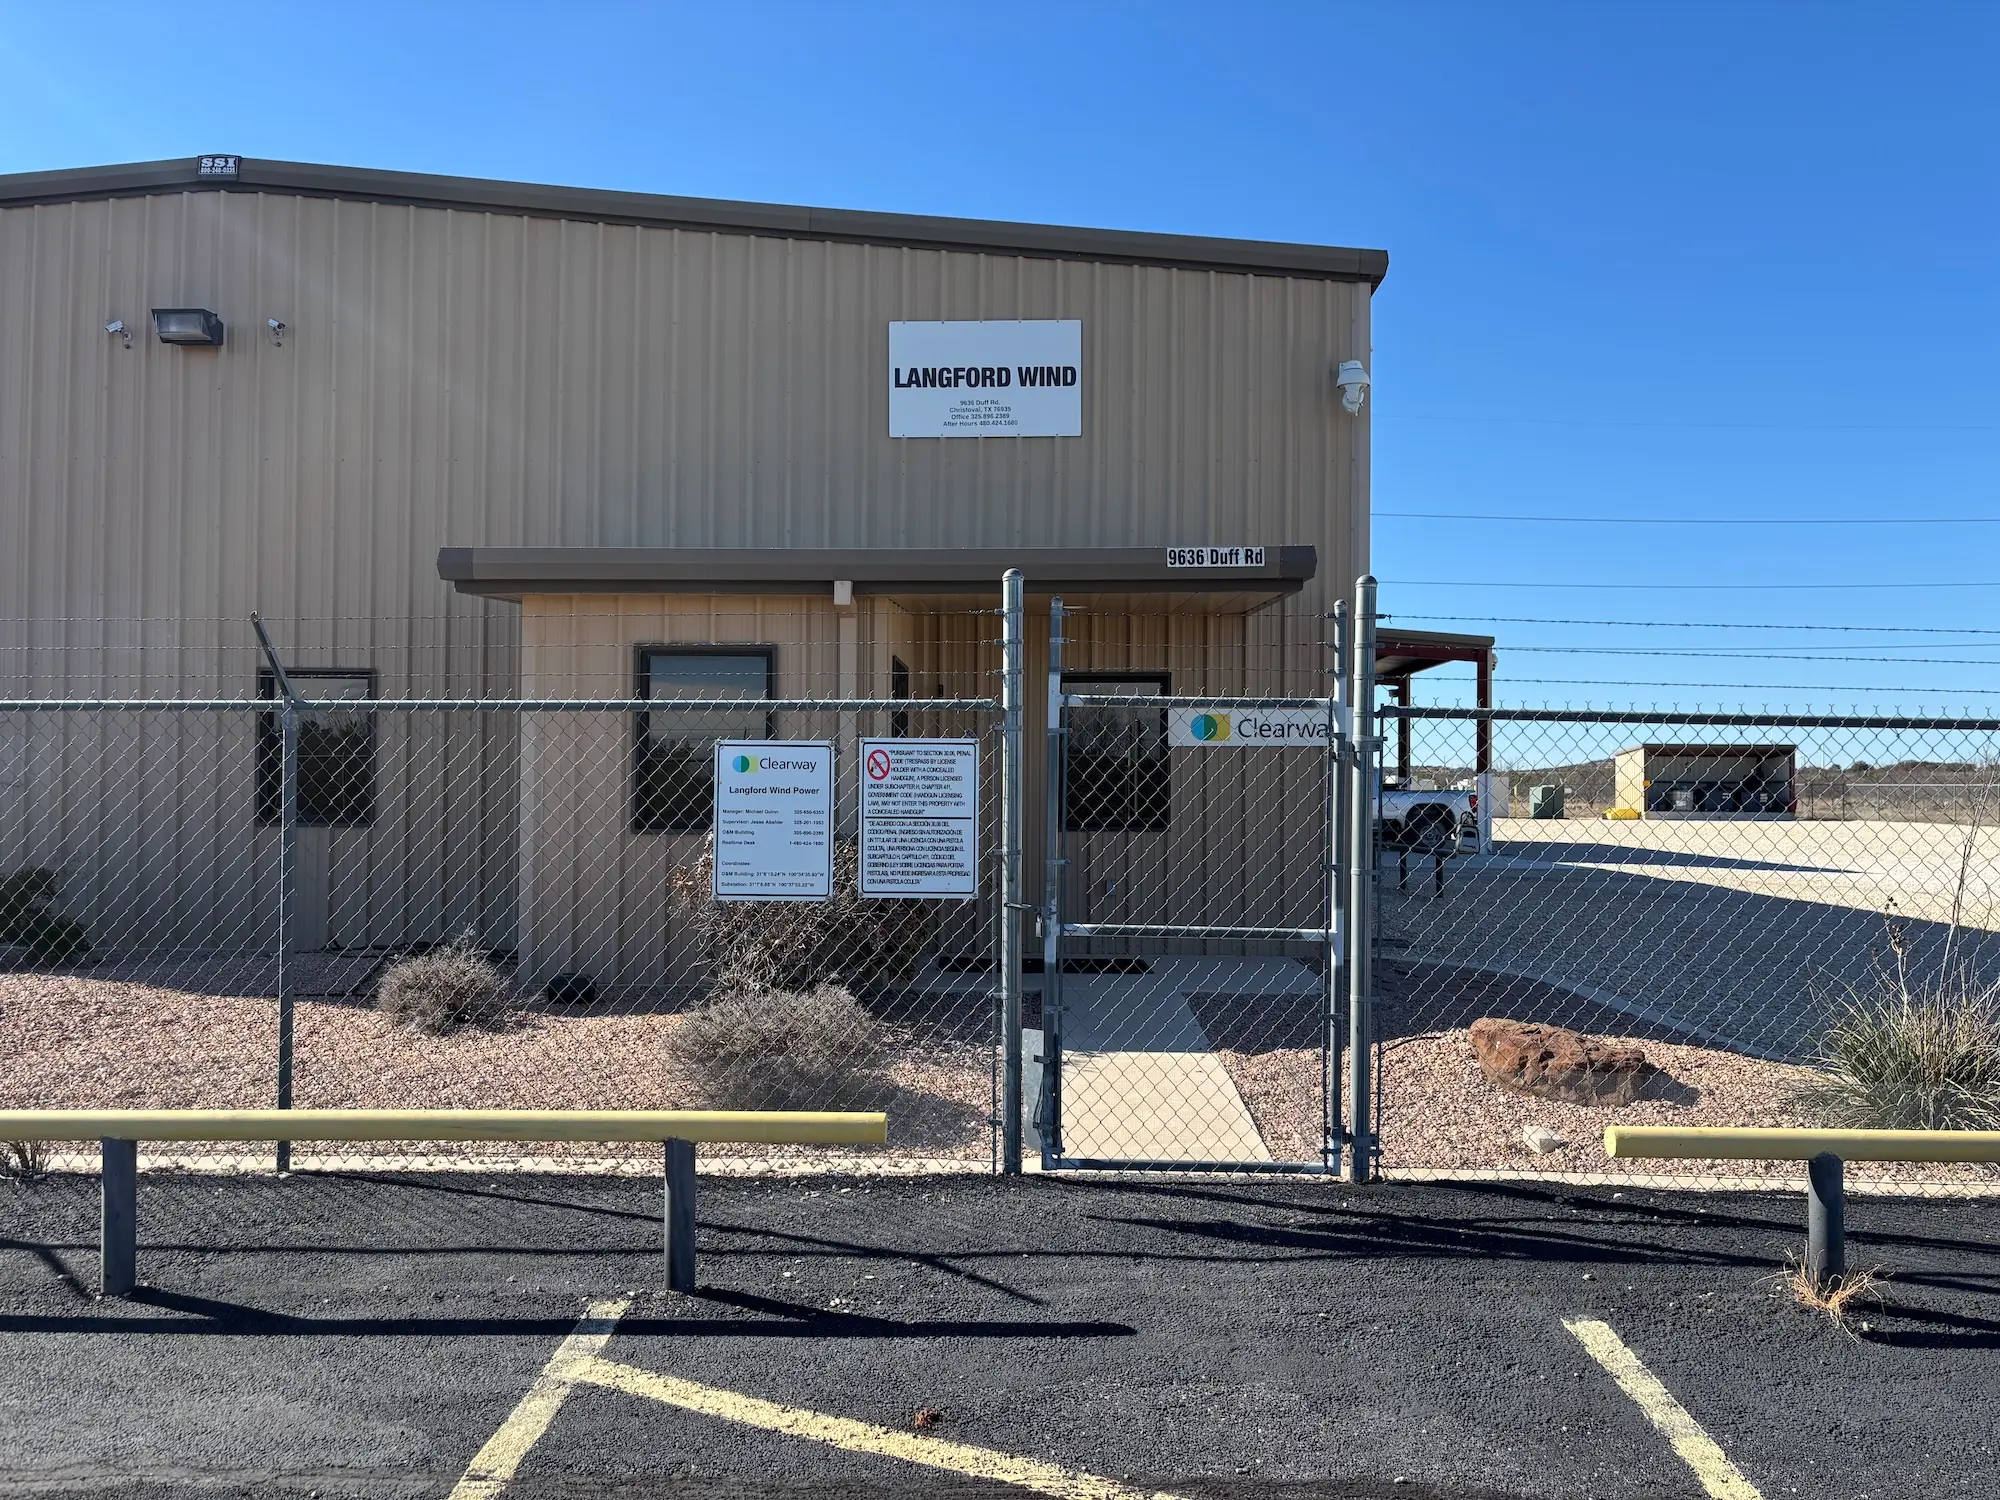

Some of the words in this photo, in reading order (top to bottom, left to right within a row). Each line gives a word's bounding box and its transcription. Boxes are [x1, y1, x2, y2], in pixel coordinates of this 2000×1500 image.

[201, 158, 235, 167] SSI
[895, 367, 1011, 388] LANGFORD
[1018, 367, 1076, 386] WIND
[1169, 549, 1204, 565] 9636
[1210, 549, 1240, 565] Duff
[1245, 549, 1262, 564] Rd
[1238, 718, 1329, 738] Clearwa
[760, 757, 816, 772] Clearway
